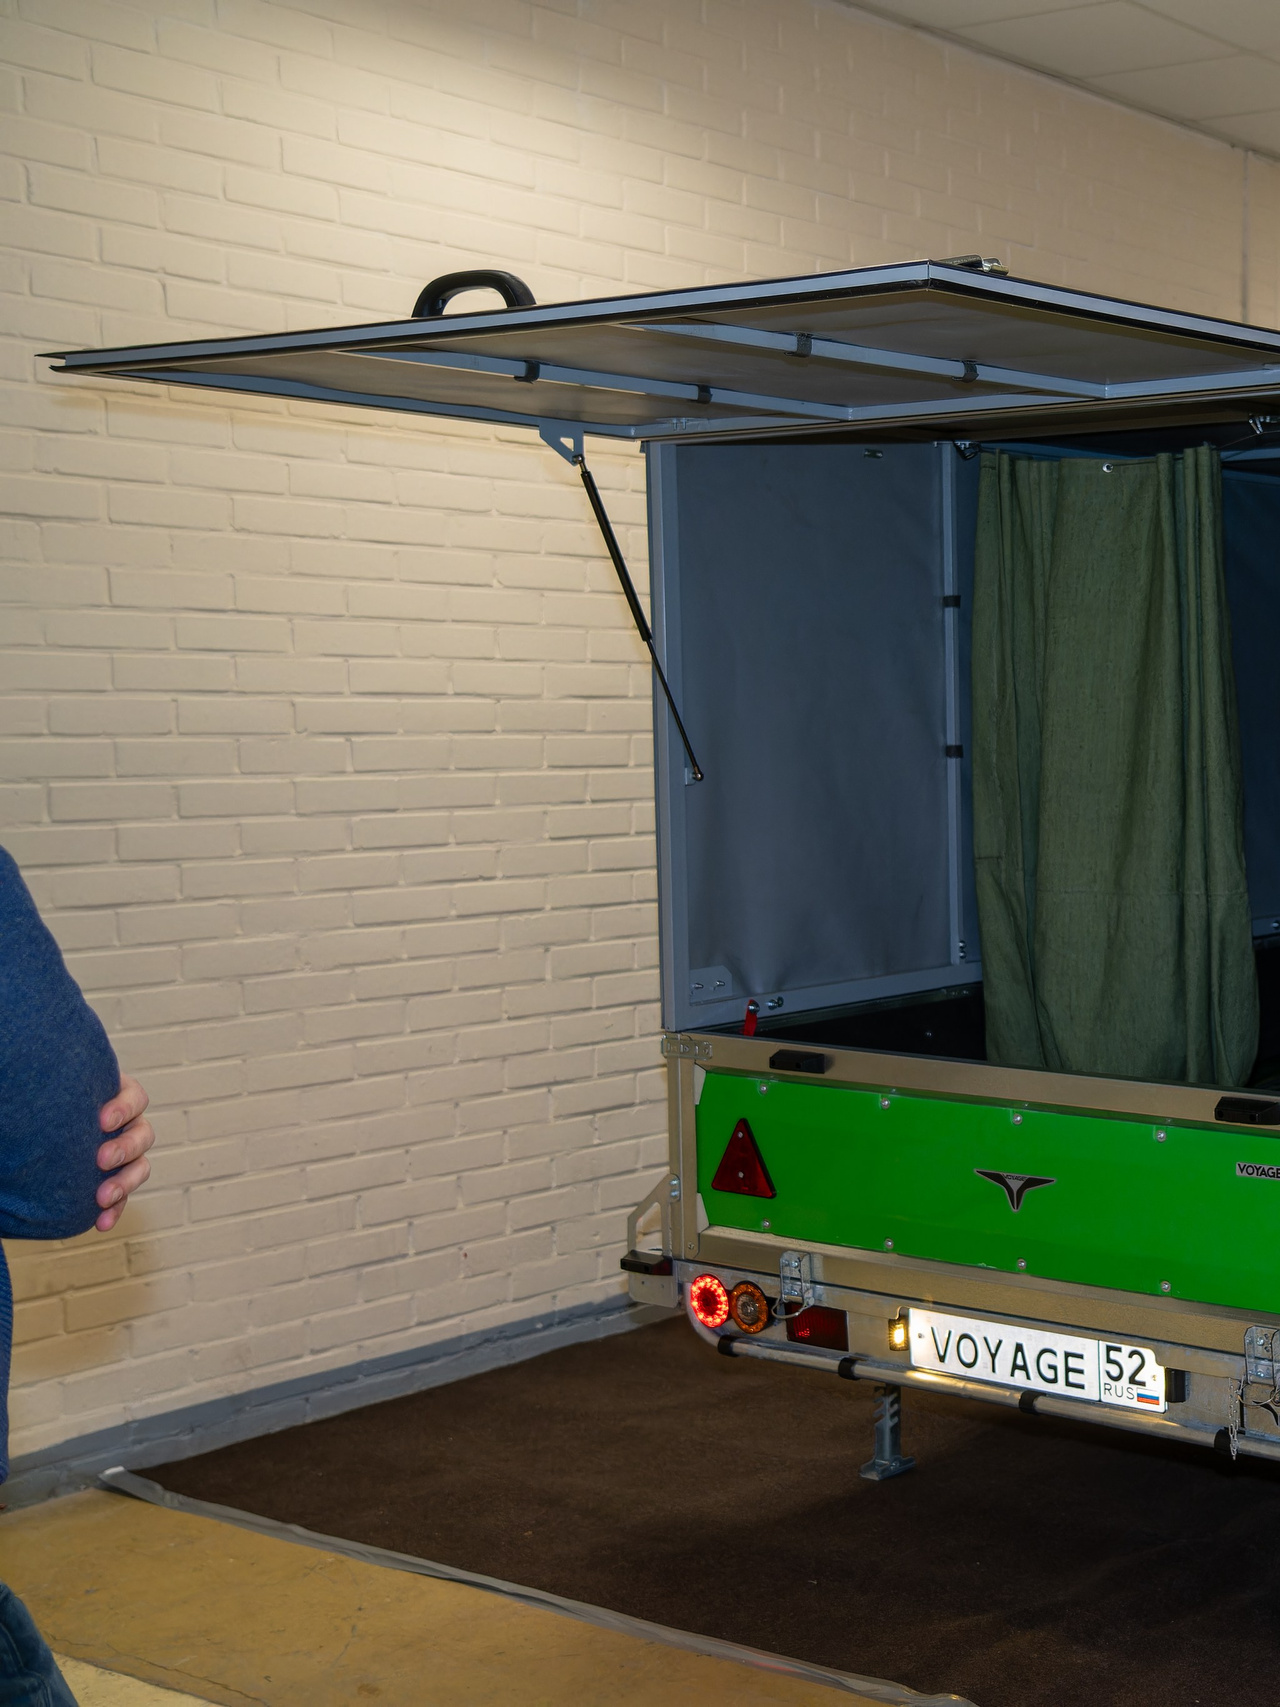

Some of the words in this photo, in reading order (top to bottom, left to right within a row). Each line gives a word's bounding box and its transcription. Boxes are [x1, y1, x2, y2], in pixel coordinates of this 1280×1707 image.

[931, 1326, 1086, 1390] VOYAGE
[1105, 1344, 1147, 1387] 52
[1103, 1382, 1135, 1400] RUS
